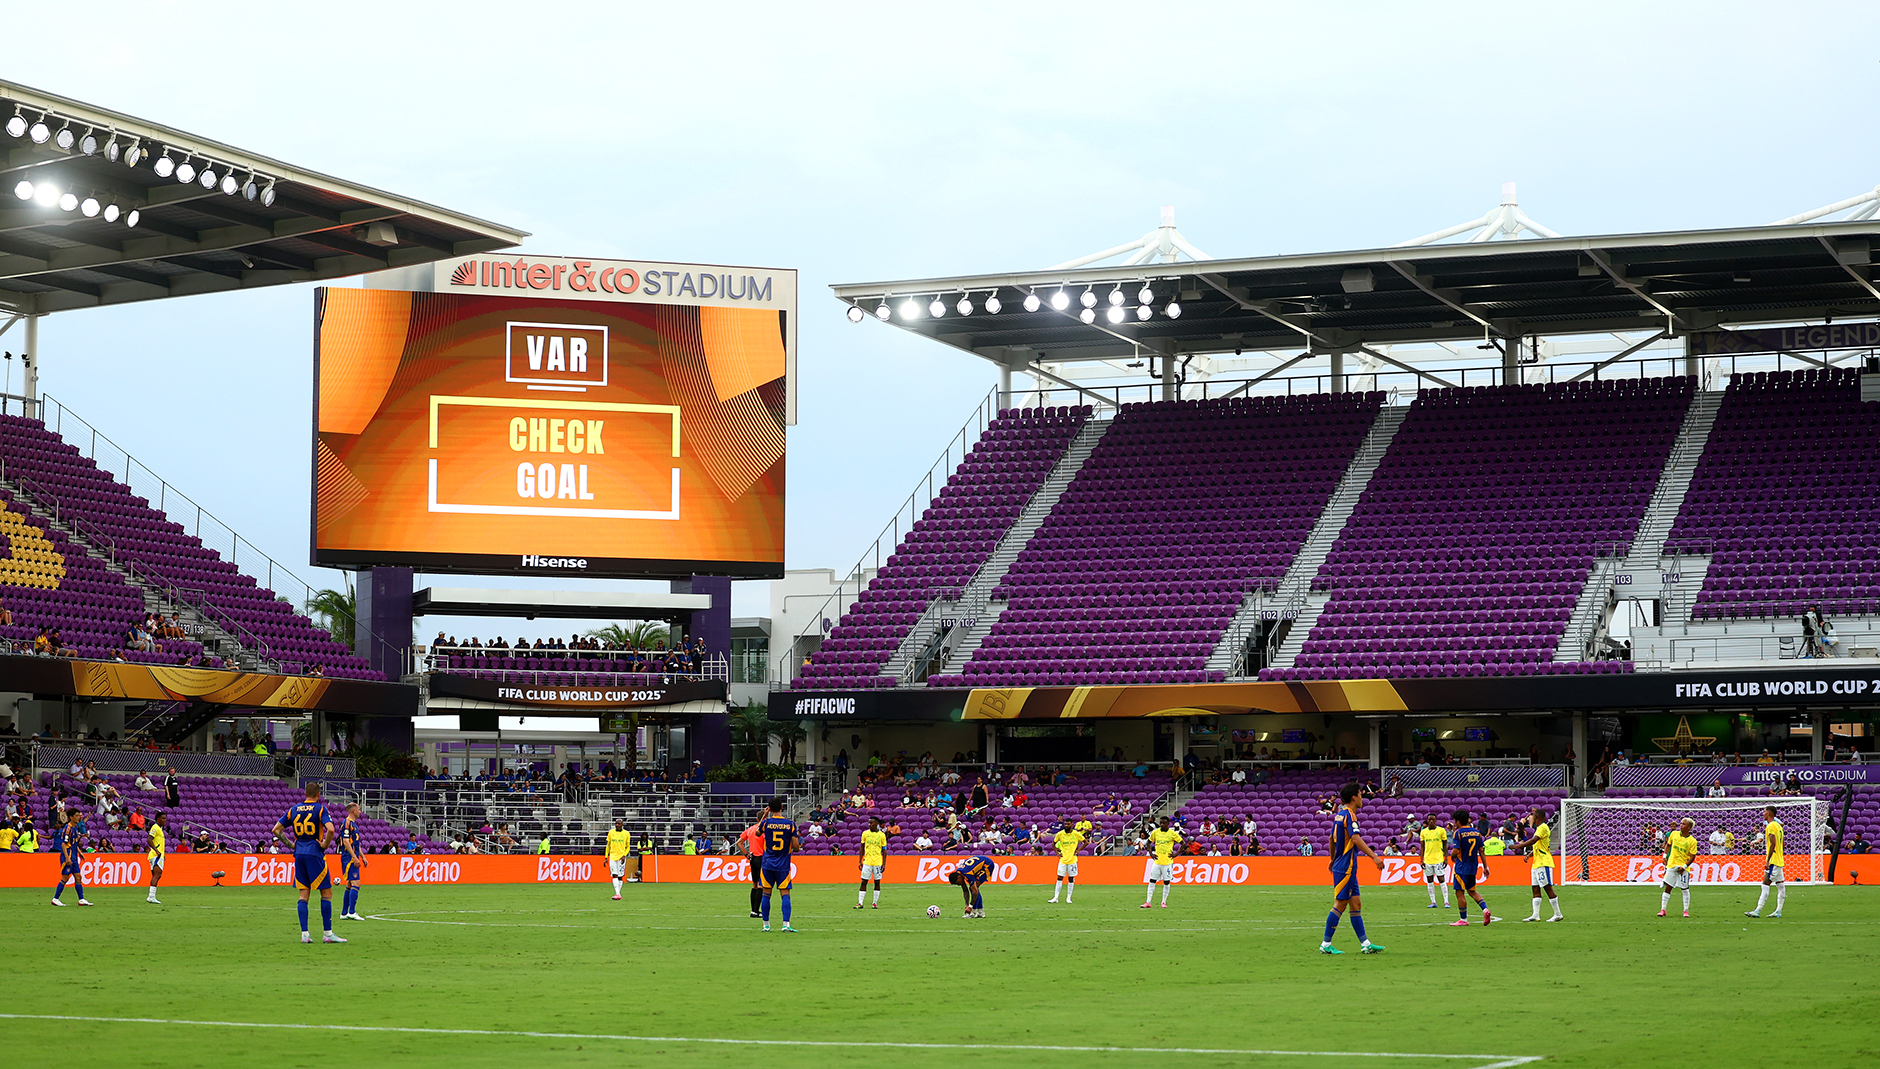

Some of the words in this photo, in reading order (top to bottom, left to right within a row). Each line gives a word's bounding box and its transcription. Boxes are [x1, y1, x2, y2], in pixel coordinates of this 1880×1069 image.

[643, 270, 772, 300] STADIUM
[1781, 324, 1880, 349] LEGEND
[526, 335, 588, 373] VAR
[509, 417, 605, 455] CHECK
[516, 462, 594, 500] GOAL
[521, 554, 588, 568] Hisense
[1615, 575, 1631, 584] 103
[1662, 574, 1678, 583] 14
[1262, 611, 1277, 620] 102
[1283, 610, 1297, 619] 03
[498, 688, 524, 699] FIFA
[526, 690, 557, 701] CLUB
[559, 691, 602, 702] WORLD
[604, 691, 629, 701] CUP
[1675, 684, 1712, 697] FIFA
[1715, 682, 1760, 697] CLUB
[1764, 681, 1828, 695] WORLD
[1832, 680, 1868, 694] CUP
[795, 698, 856, 715] #FIFACWC
[1815, 770, 1867, 781] STADIUM
[293, 813, 315, 836] 66
[772, 831, 784, 851] 5
[1468, 838, 1476, 856] 7
[241, 856, 295, 884] Beta
[399, 857, 461, 882] Betano
[537, 857, 592, 881] Betano
[1626, 857, 1741, 882] Beano
